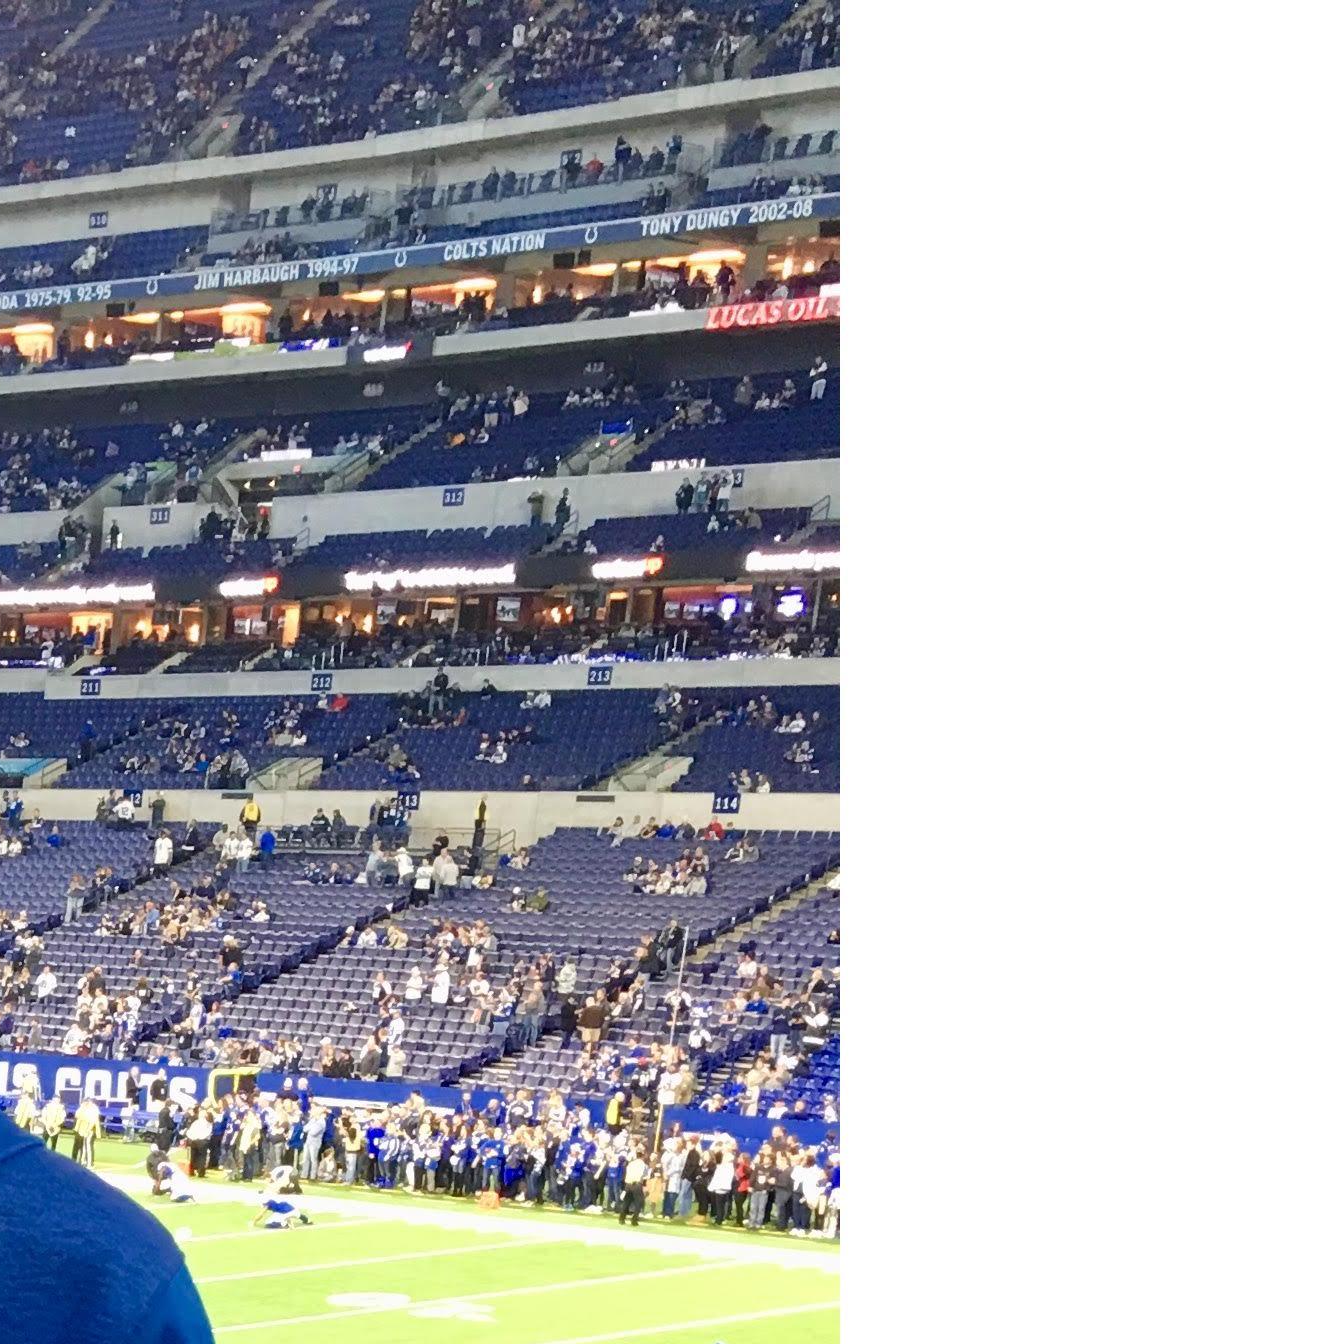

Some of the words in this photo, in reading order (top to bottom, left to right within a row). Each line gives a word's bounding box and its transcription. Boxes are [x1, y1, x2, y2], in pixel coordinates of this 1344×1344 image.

[641, 215, 683, 238] TONY
[685, 207, 742, 231] DUNGY
[749, 199, 813, 223] 2002-08
[77, 284, 112, 302] 92-95
[194, 271, 219, 291] JIM
[223, 264, 300, 287] HARBAUGH
[306, 256, 360, 279] 1994-97
[443, 240, 488, 262] COLTS
[491, 233, 546, 256] NATION
[705, 301, 784, 330] LUCAS
[788, 296, 830, 322] OIL
[313, 676, 331, 688] 212
[588, 670, 611, 683] 213
[81, 682, 100, 693] 211
[715, 796, 739, 810] 114
